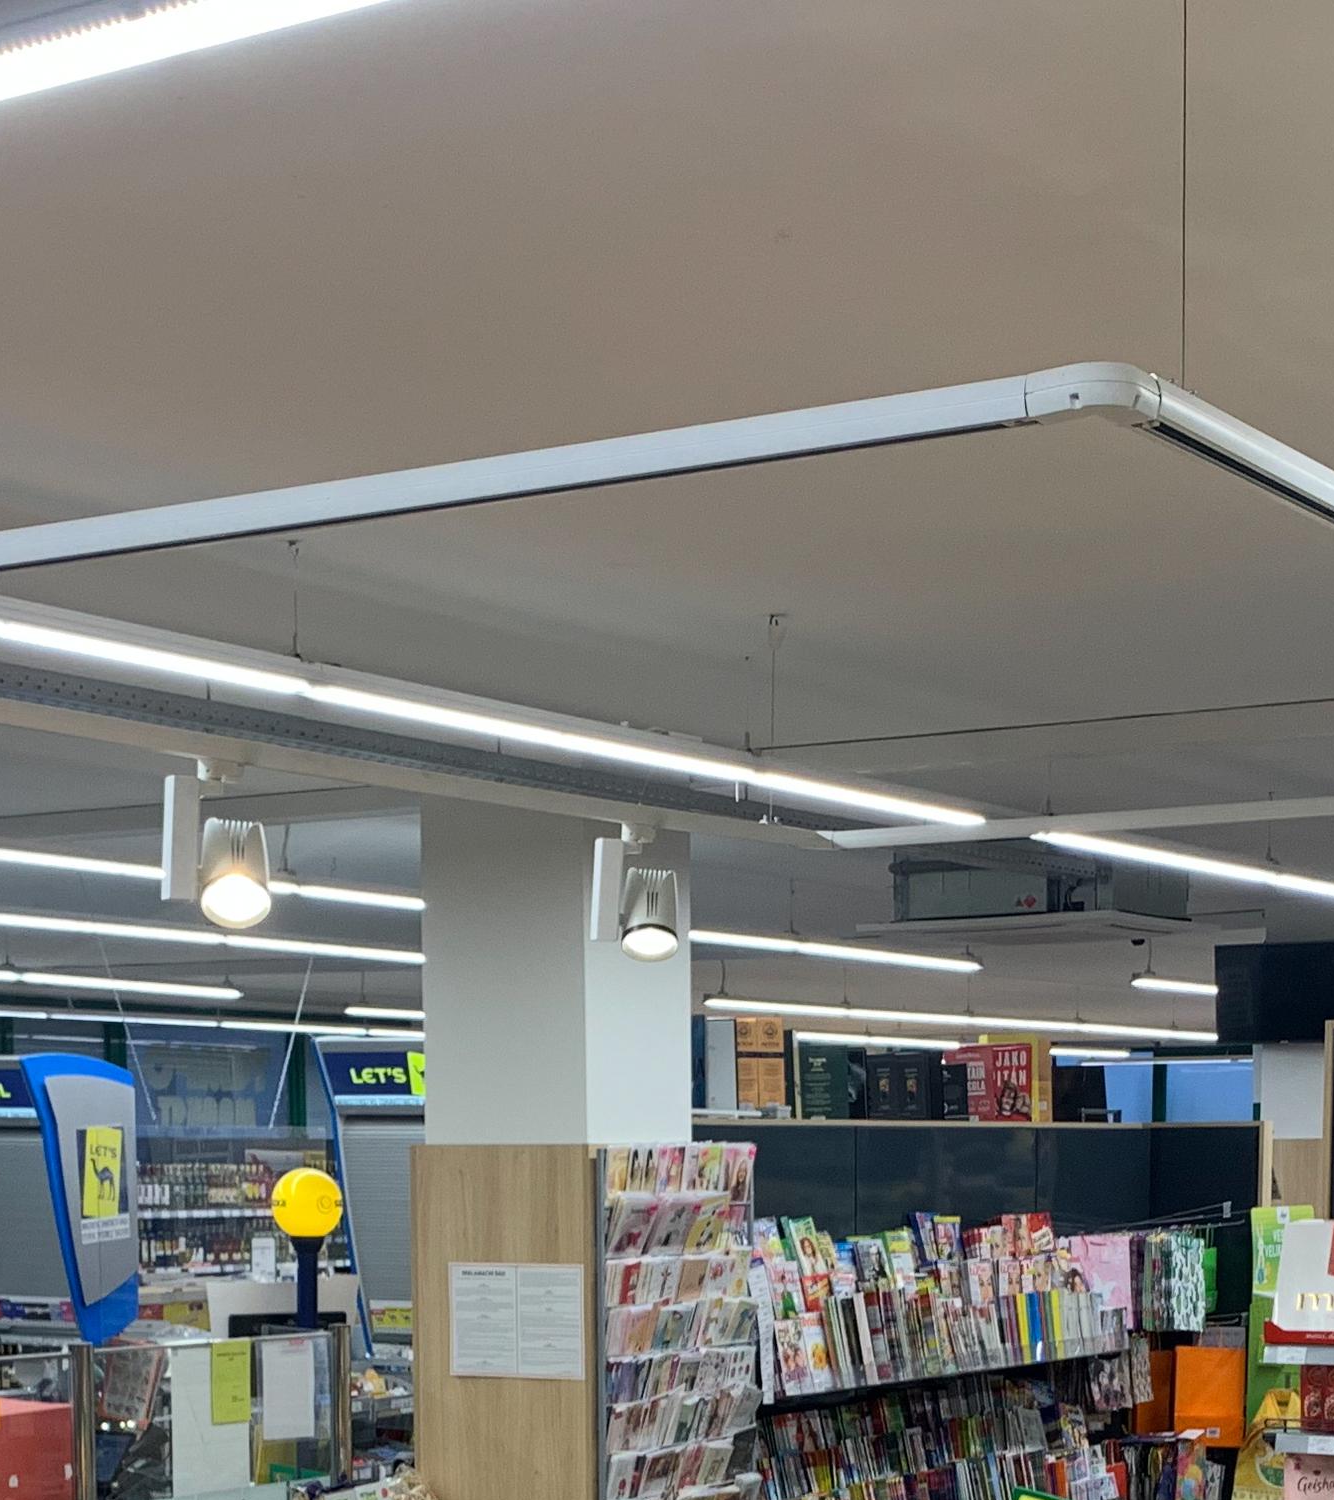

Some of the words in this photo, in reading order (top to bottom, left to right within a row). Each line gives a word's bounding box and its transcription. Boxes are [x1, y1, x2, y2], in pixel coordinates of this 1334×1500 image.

[995, 1051, 1027, 1067] JAKO
[349, 1066, 408, 1085] LET'S
[89, 1144, 117, 1159] LET'S
